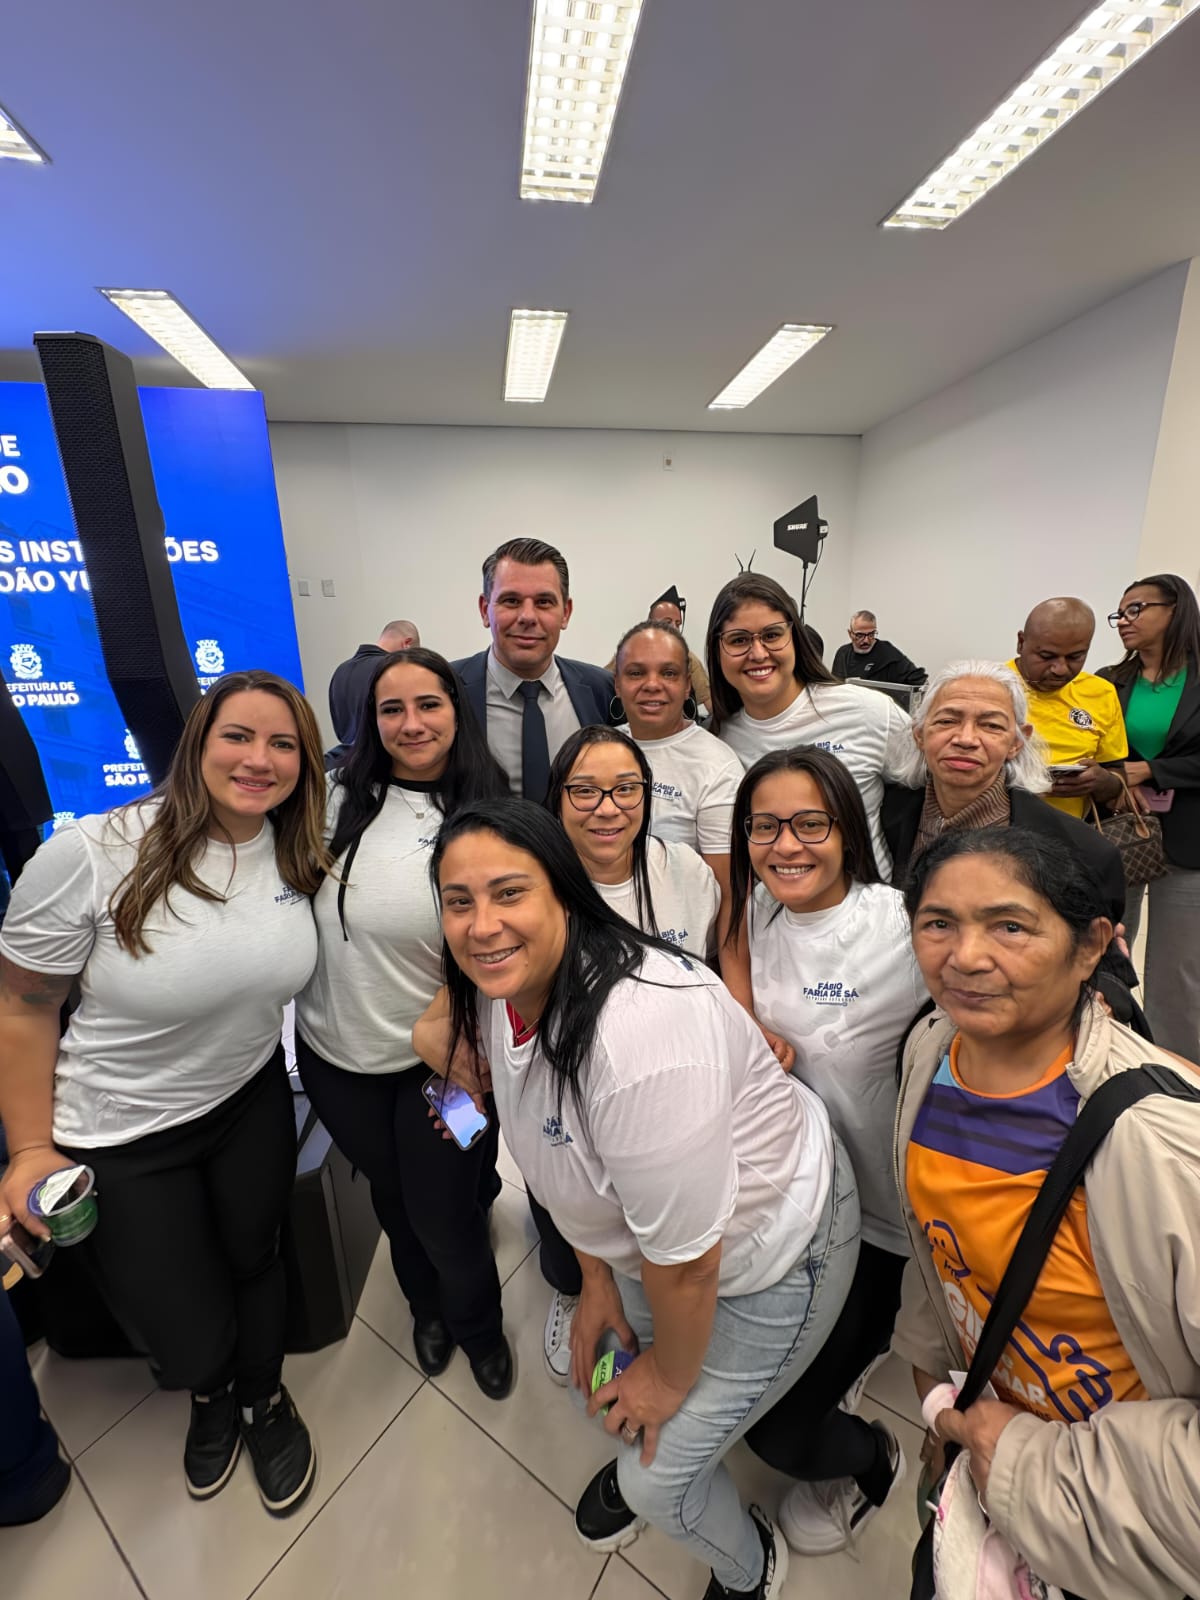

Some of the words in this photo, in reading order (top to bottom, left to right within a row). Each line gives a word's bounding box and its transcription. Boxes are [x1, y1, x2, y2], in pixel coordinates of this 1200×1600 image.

[0, 435, 21, 457] E
[0, 465, 29, 494] O
[0, 540, 16, 563] S
[0, 566, 55, 593] OÃO
[6, 681, 58, 693] EFEITURA
[59, 681, 76, 691] DE
[27, 692, 80, 707] PAULO
[105, 772, 137, 787] SÃO
[661, 928, 676, 939] BIO
[803, 987, 828, 998] FARIA
[829, 989, 842, 998] DE
[844, 987, 860, 998] SÁ
[818, 981, 843, 991] FÁBIO
